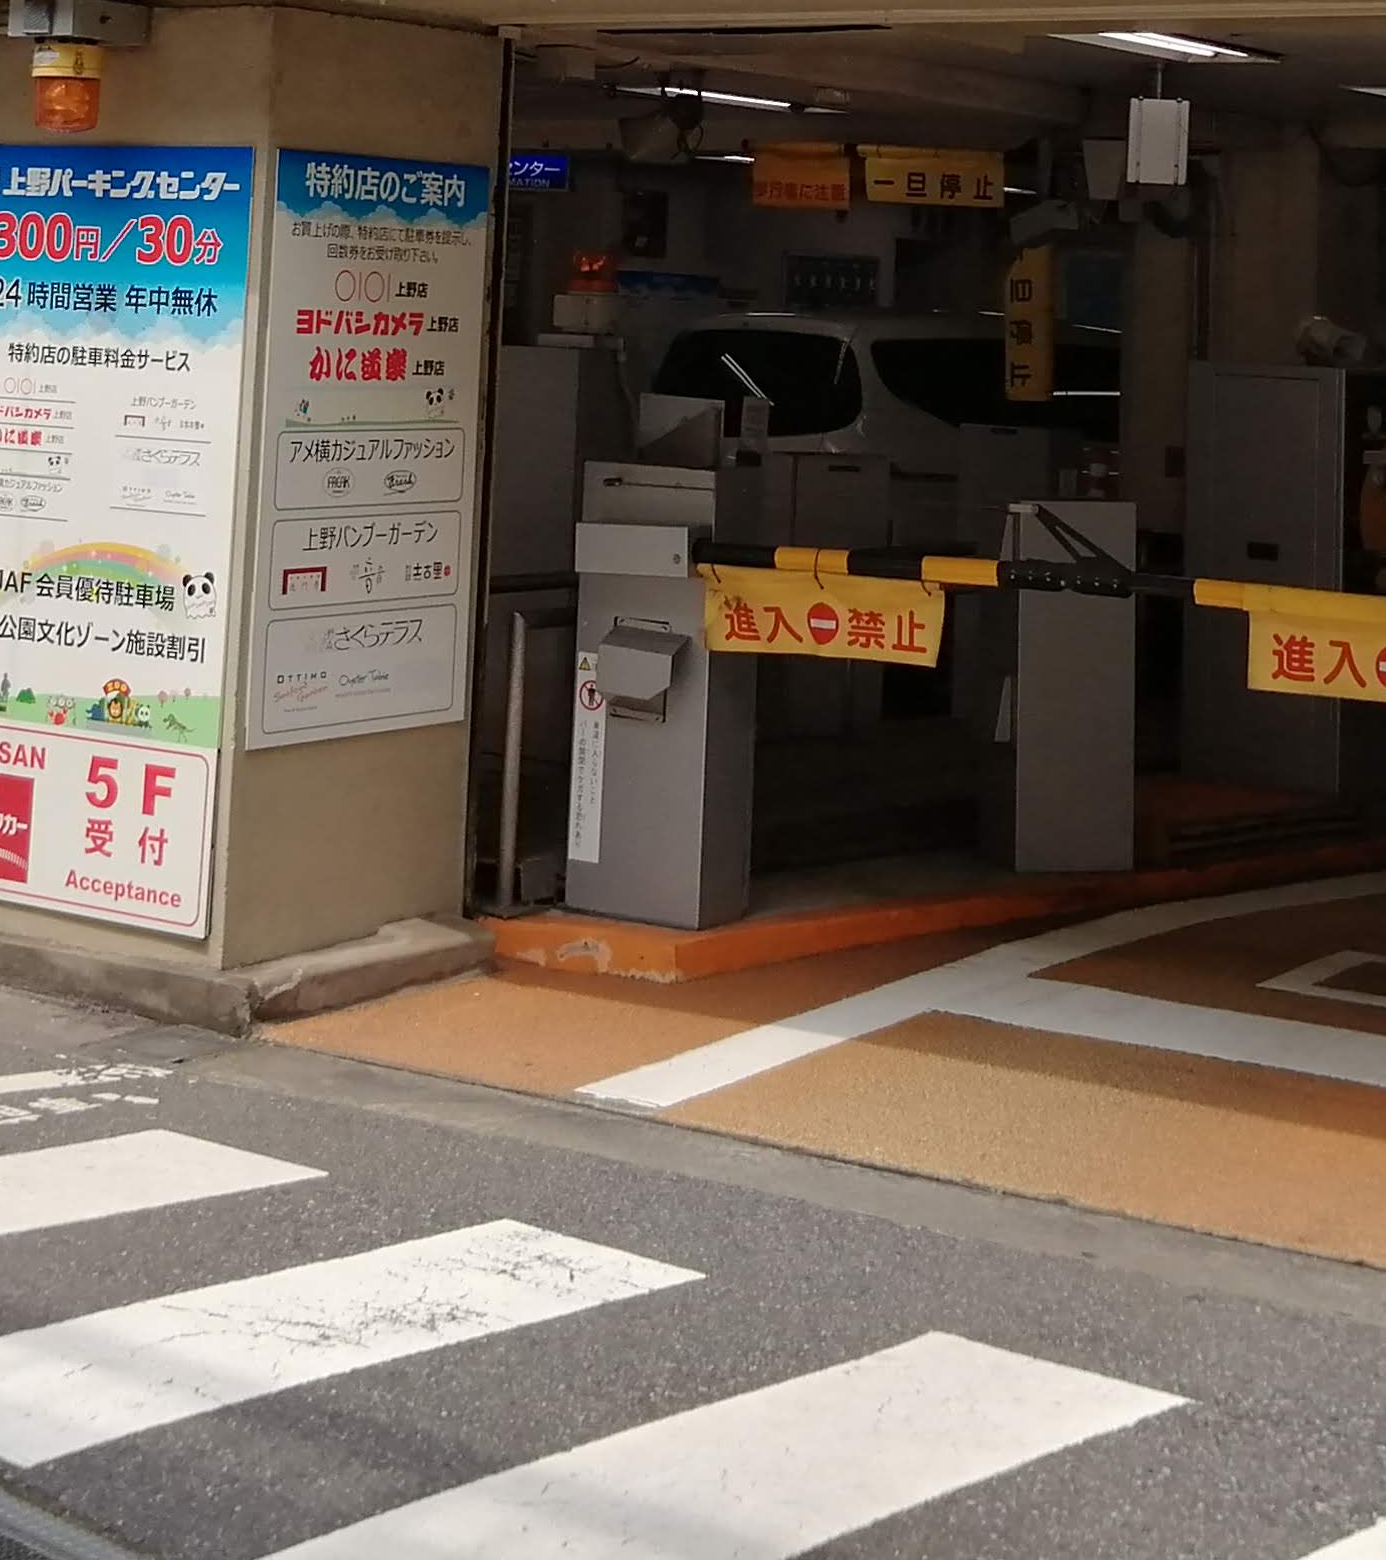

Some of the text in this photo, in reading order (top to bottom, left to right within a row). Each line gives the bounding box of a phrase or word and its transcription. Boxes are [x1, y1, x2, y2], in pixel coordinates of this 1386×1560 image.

[2, 166, 242, 202] 上野パーキングセンター
[304, 159, 467, 208] 特約店のご案内
[873, 171, 994, 201] 一旦停止
[124, 283, 219, 318] 年中無休
[394, 281, 429, 299] 上野店
[295, 308, 461, 337] ヨドバシカメラ 上野店
[7, 342, 192, 373] 特約店の駐車料金サービス
[412, 359, 446, 377] 上野店
[289, 438, 456, 464] アメ横カジュアルファッション
[34, 573, 176, 613] 会員優待駐車場
[64, 868, 183, 909] Acceptance
